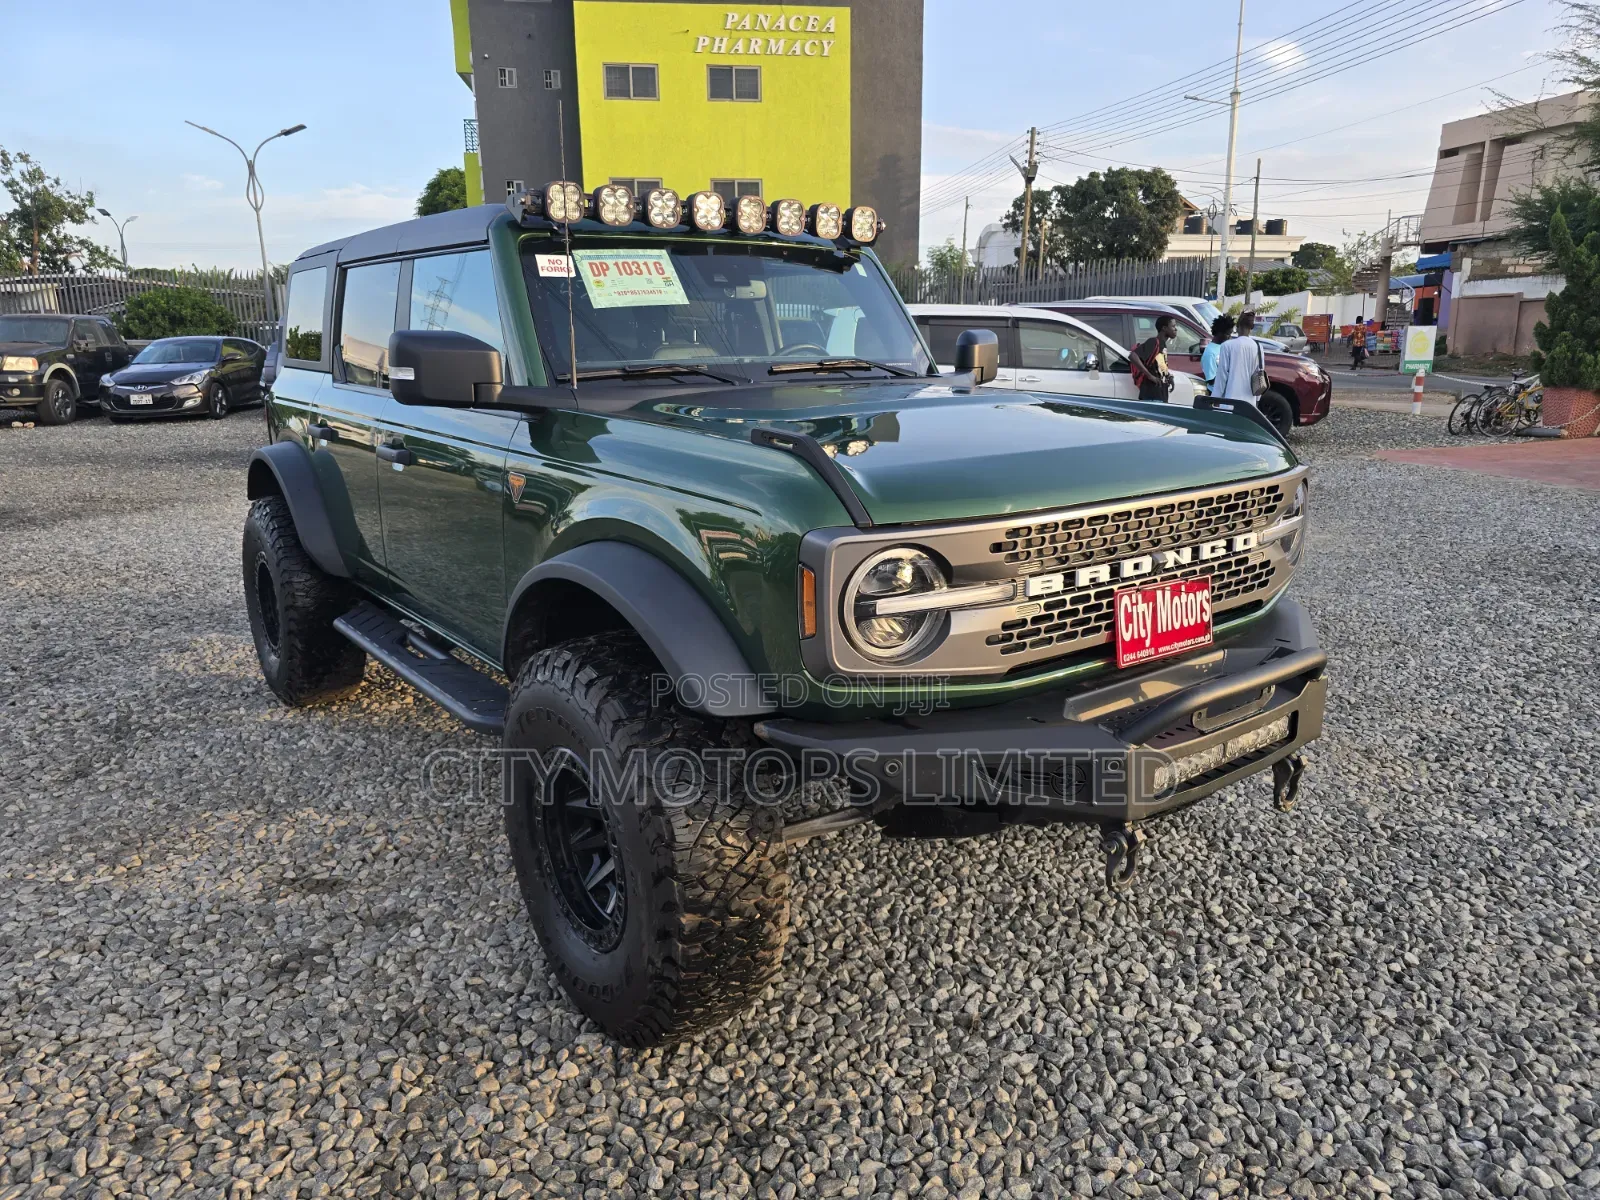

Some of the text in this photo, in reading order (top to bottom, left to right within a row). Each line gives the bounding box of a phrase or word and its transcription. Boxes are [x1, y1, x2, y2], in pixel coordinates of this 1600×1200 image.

[724, 12, 836, 33] PANACEA
[694, 36, 836, 57] PHARMACY
[588, 260, 666, 278] DP 1031 G
[1025, 532, 1258, 597] BRONCO
[1120, 584, 1211, 648] City Motors
